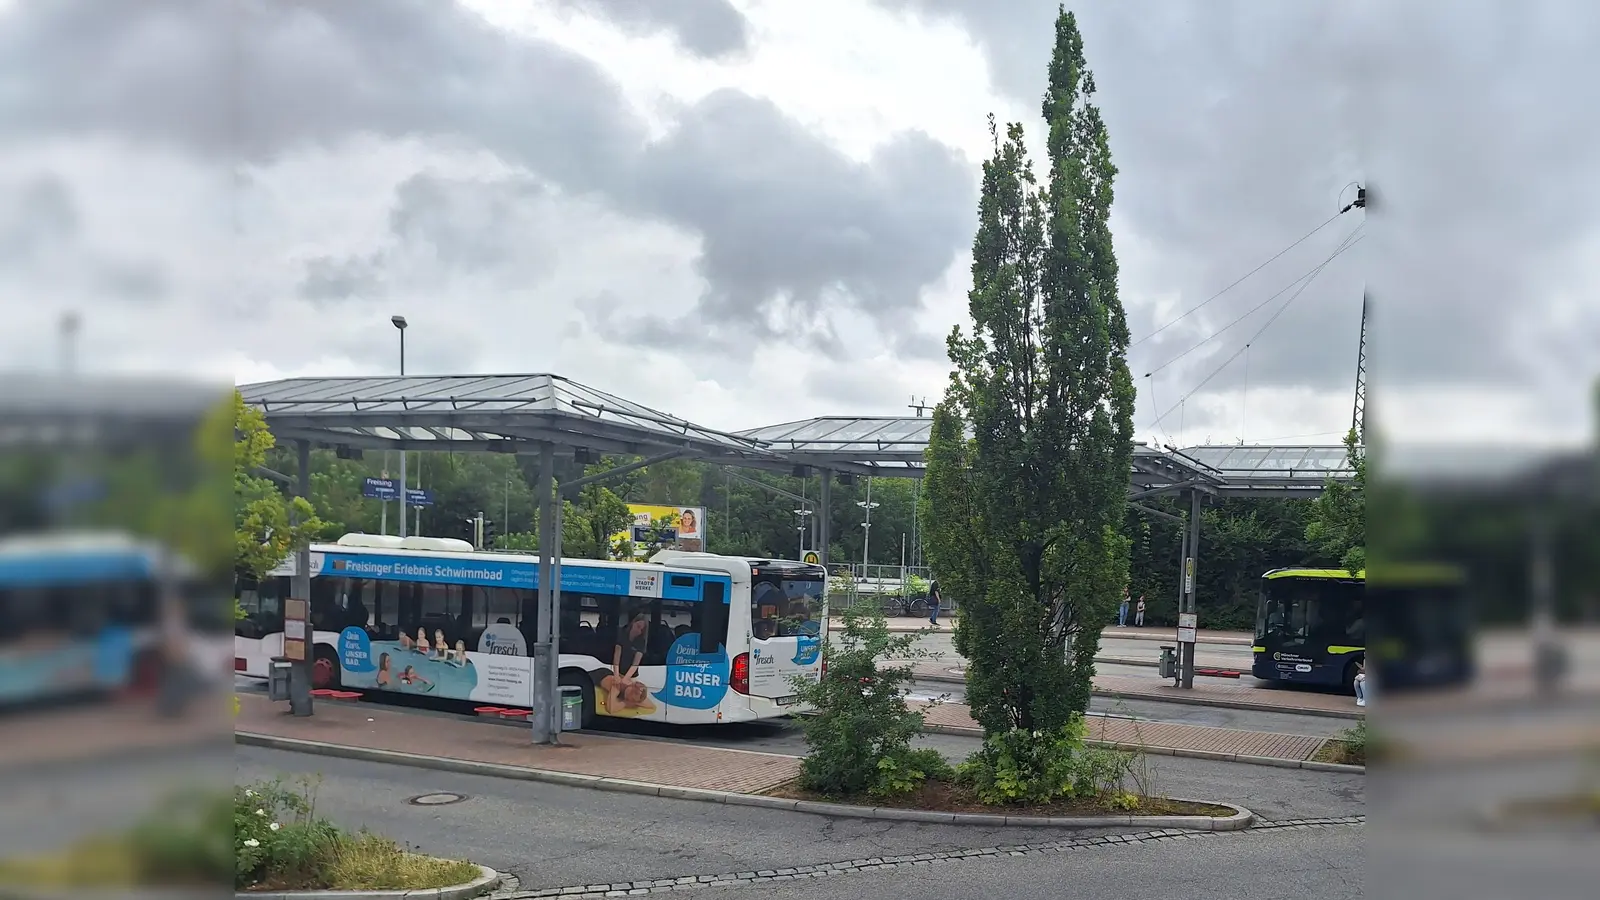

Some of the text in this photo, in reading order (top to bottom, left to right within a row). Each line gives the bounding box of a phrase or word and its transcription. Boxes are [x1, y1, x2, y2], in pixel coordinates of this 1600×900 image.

[366, 478, 392, 487] Freising
[345, 560, 392, 576] Freisinger
[394, 563, 433, 576] Erlebnis
[434, 565, 503, 580] Schwimmbad
[345, 650, 368, 659] UNSER
[490, 641, 518, 656] fresch
[345, 658, 361, 666] BAD.
[755, 654, 775, 665] fresch
[675, 671, 721, 686] UNSER
[674, 684, 706, 699] BAD.
